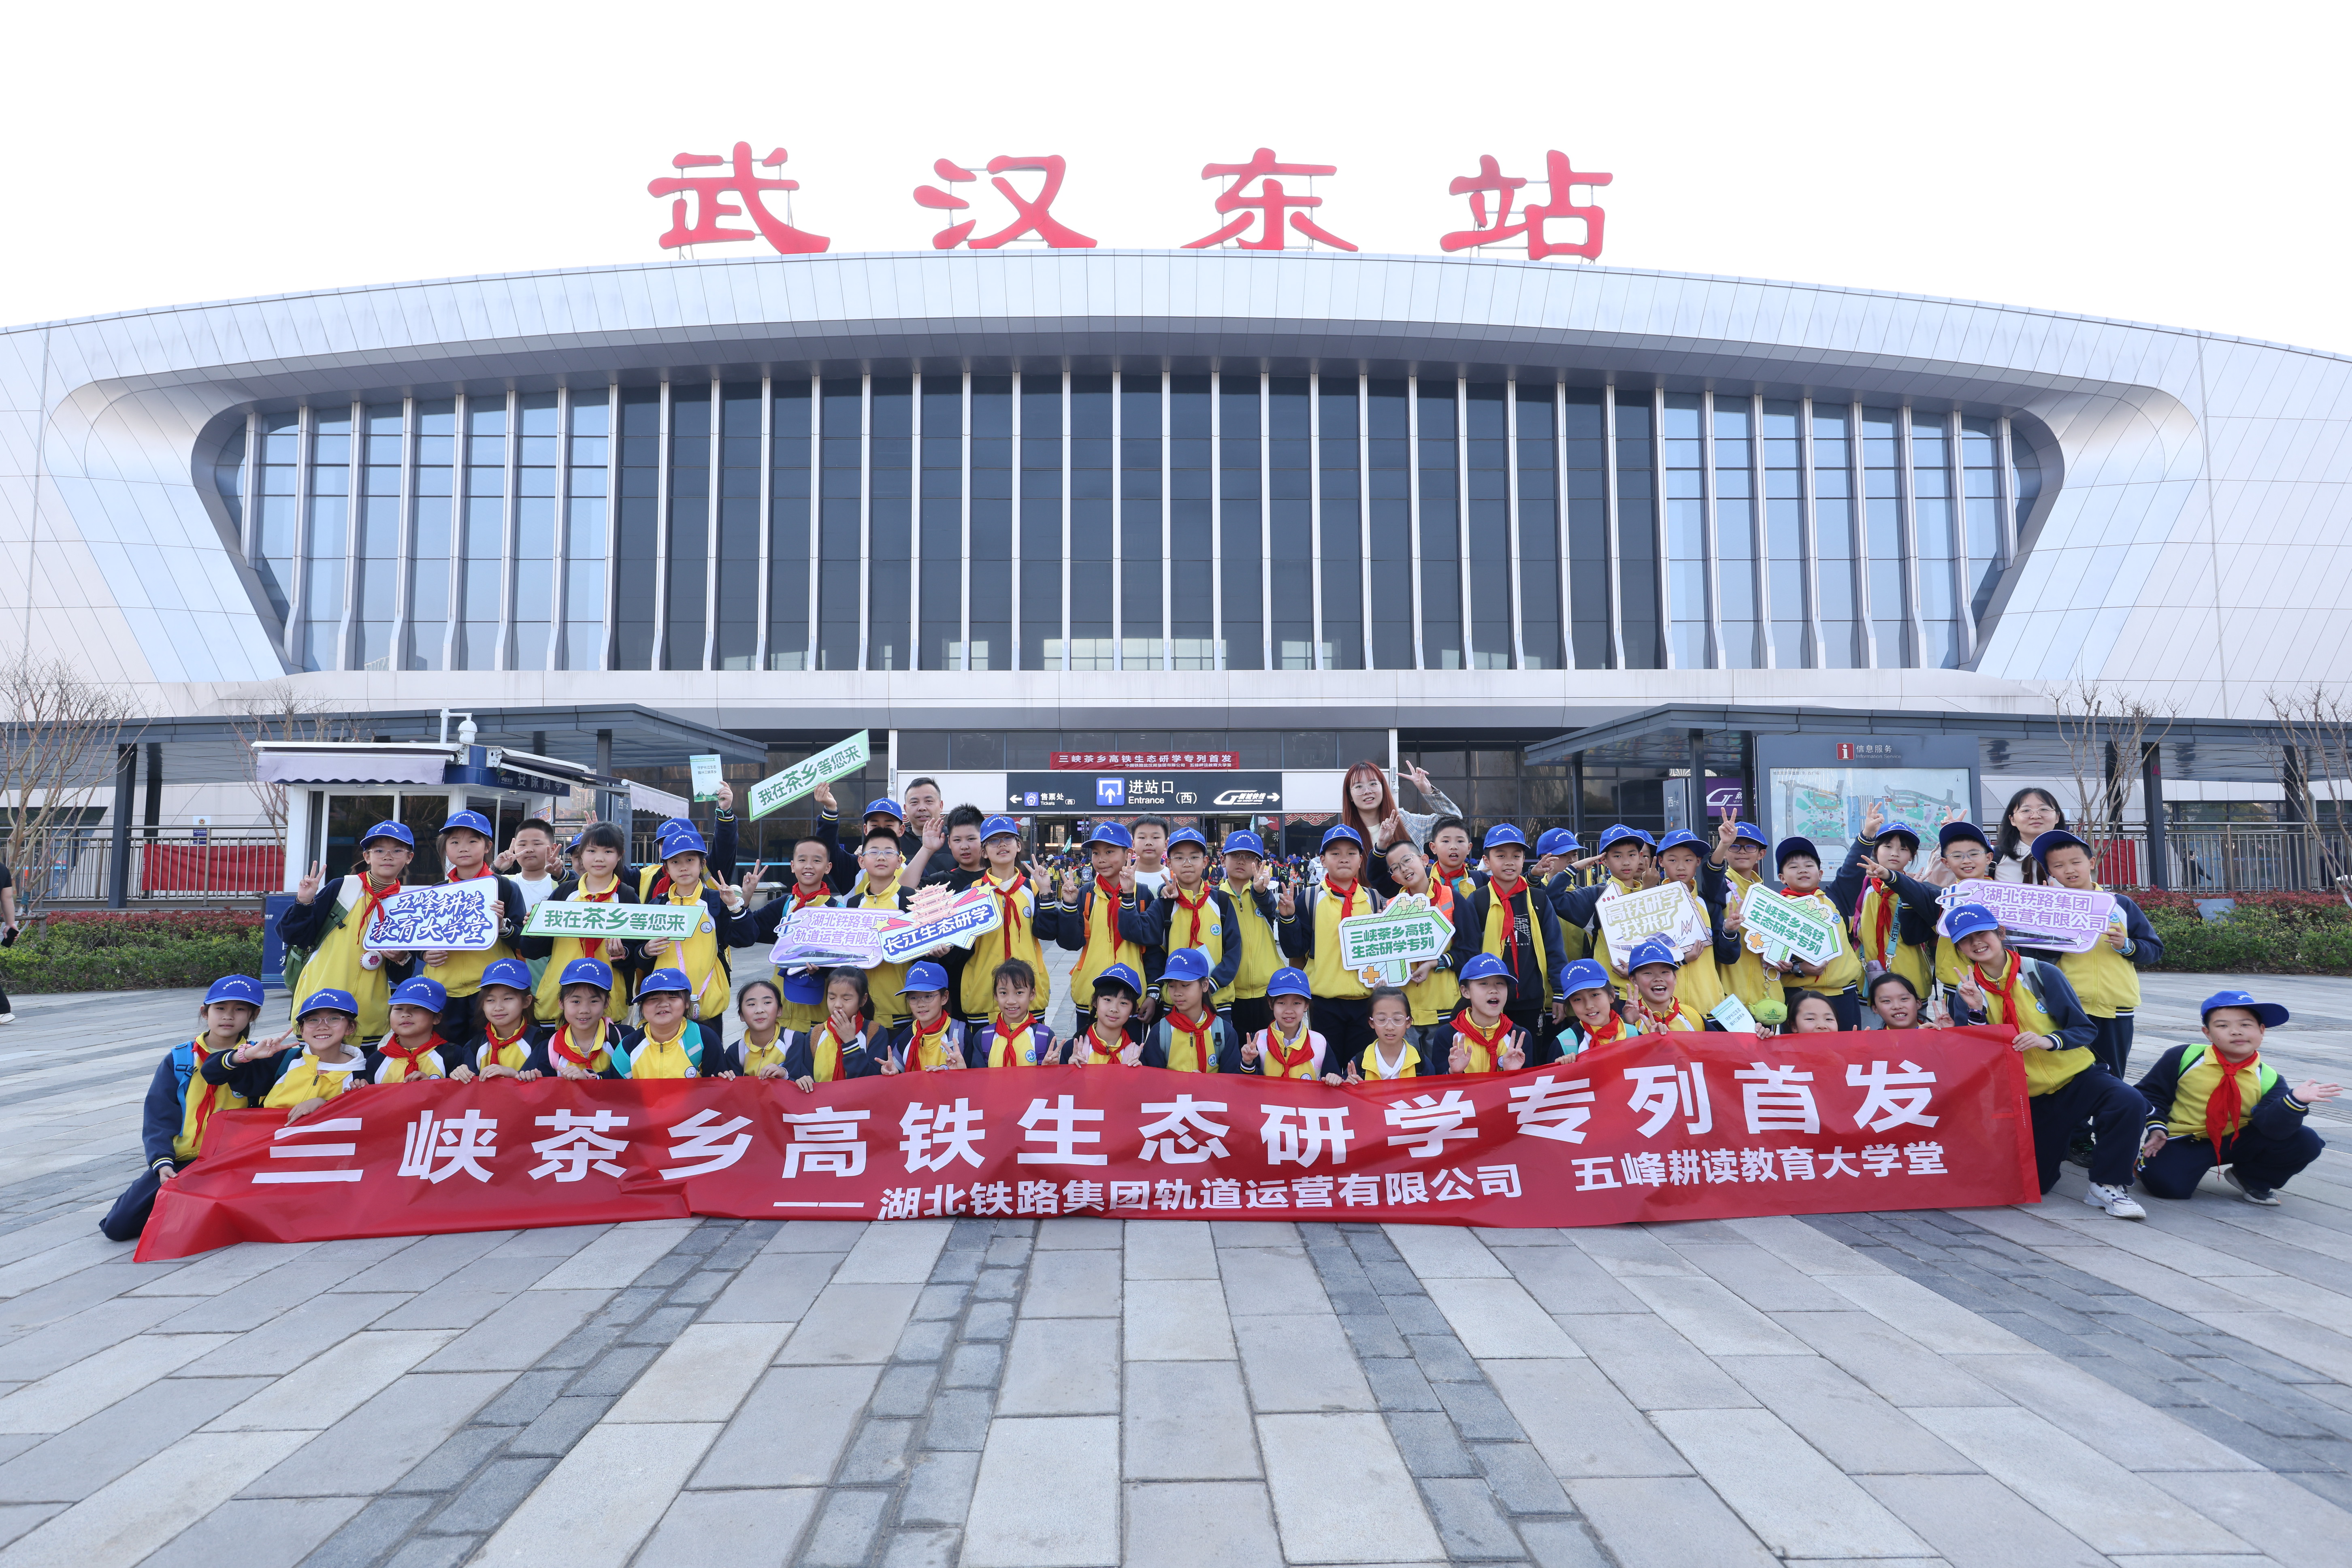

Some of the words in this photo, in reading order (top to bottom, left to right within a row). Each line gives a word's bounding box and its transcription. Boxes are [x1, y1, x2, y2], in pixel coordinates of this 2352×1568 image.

[648, 142, 1613, 260] 武汉东站
[1058, 755, 1232, 763] 三峡茶乡高铁生态研学专列首发
[1856, 745, 1892, 753] 信息服务
[758, 745, 861, 806] 我在茶乡等您来
[1128, 780, 1174, 794] 进站口
[1040, 793, 1064, 801] 售票处
[390, 891, 484, 918] 五峰耕读
[1606, 888, 1683, 925] 高铁研学
[1985, 887, 2090, 912] 湖北铁路集团
[370, 915, 491, 943] 教育大学堂
[544, 907, 685, 931] 我在茶乡等您来
[885, 905, 993, 952] 长江生态研学
[1621, 908, 1676, 940] 我来了
[1753, 897, 1826, 943] 三峡茶乡高铁
[1968, 902, 2107, 930] 道运营有限公司
[794, 929, 879, 945] 轨道运营有限公
[1350, 922, 1433, 944] 三峡茶乡高铁
[1748, 910, 1822, 955] 生态研学专列
[1891, 922, 1900, 942] HELEN
[1351, 936, 1434, 959] 生态研学专列
[1725, 1007, 1741, 1021] 守护长江生态
[251, 1060, 1941, 1185] 三峡茶乡高铁生态研学专列首发
[1571, 1140, 1948, 1193] 五峰耕读教育大学堂
